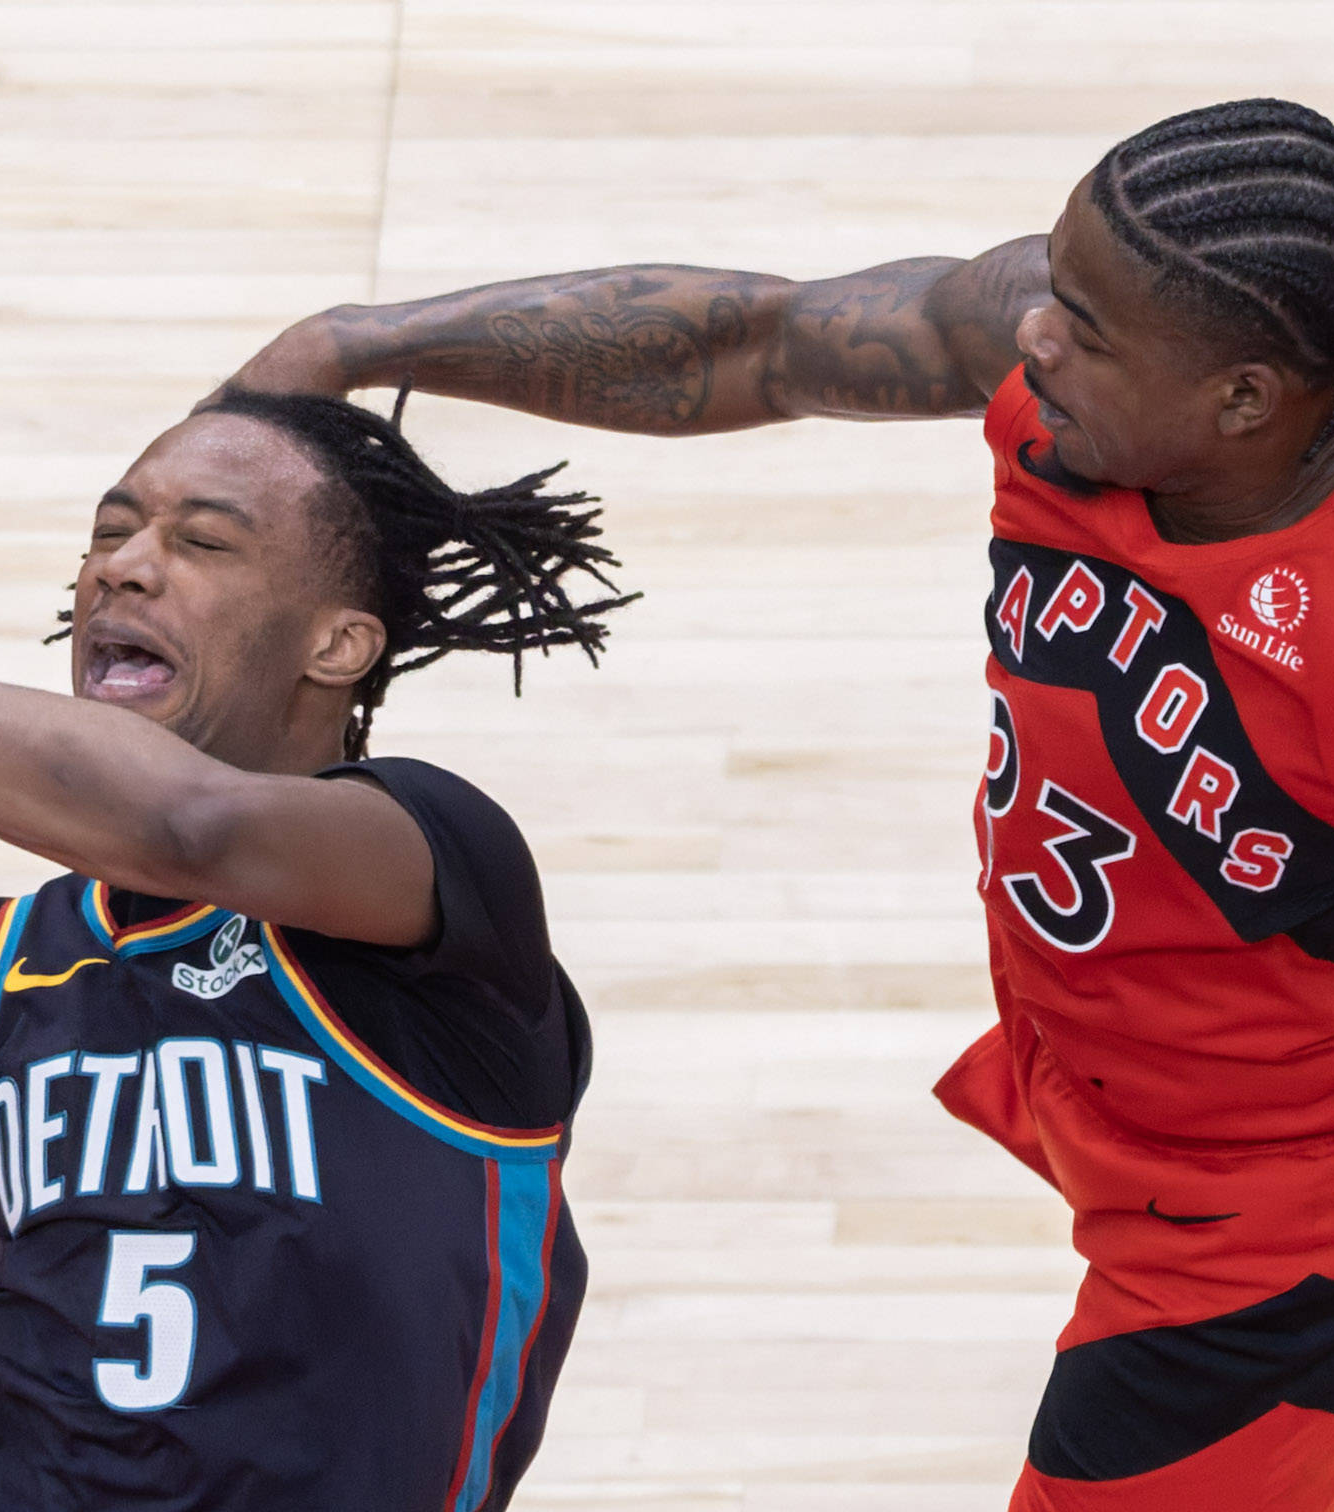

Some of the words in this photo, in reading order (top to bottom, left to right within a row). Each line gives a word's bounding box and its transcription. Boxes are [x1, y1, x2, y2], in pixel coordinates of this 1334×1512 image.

[993, 559, 1294, 893] APTORS
[1217, 613, 1260, 650] Sun
[1262, 635, 1304, 672] Life
[92, 1229, 199, 1413] 5
